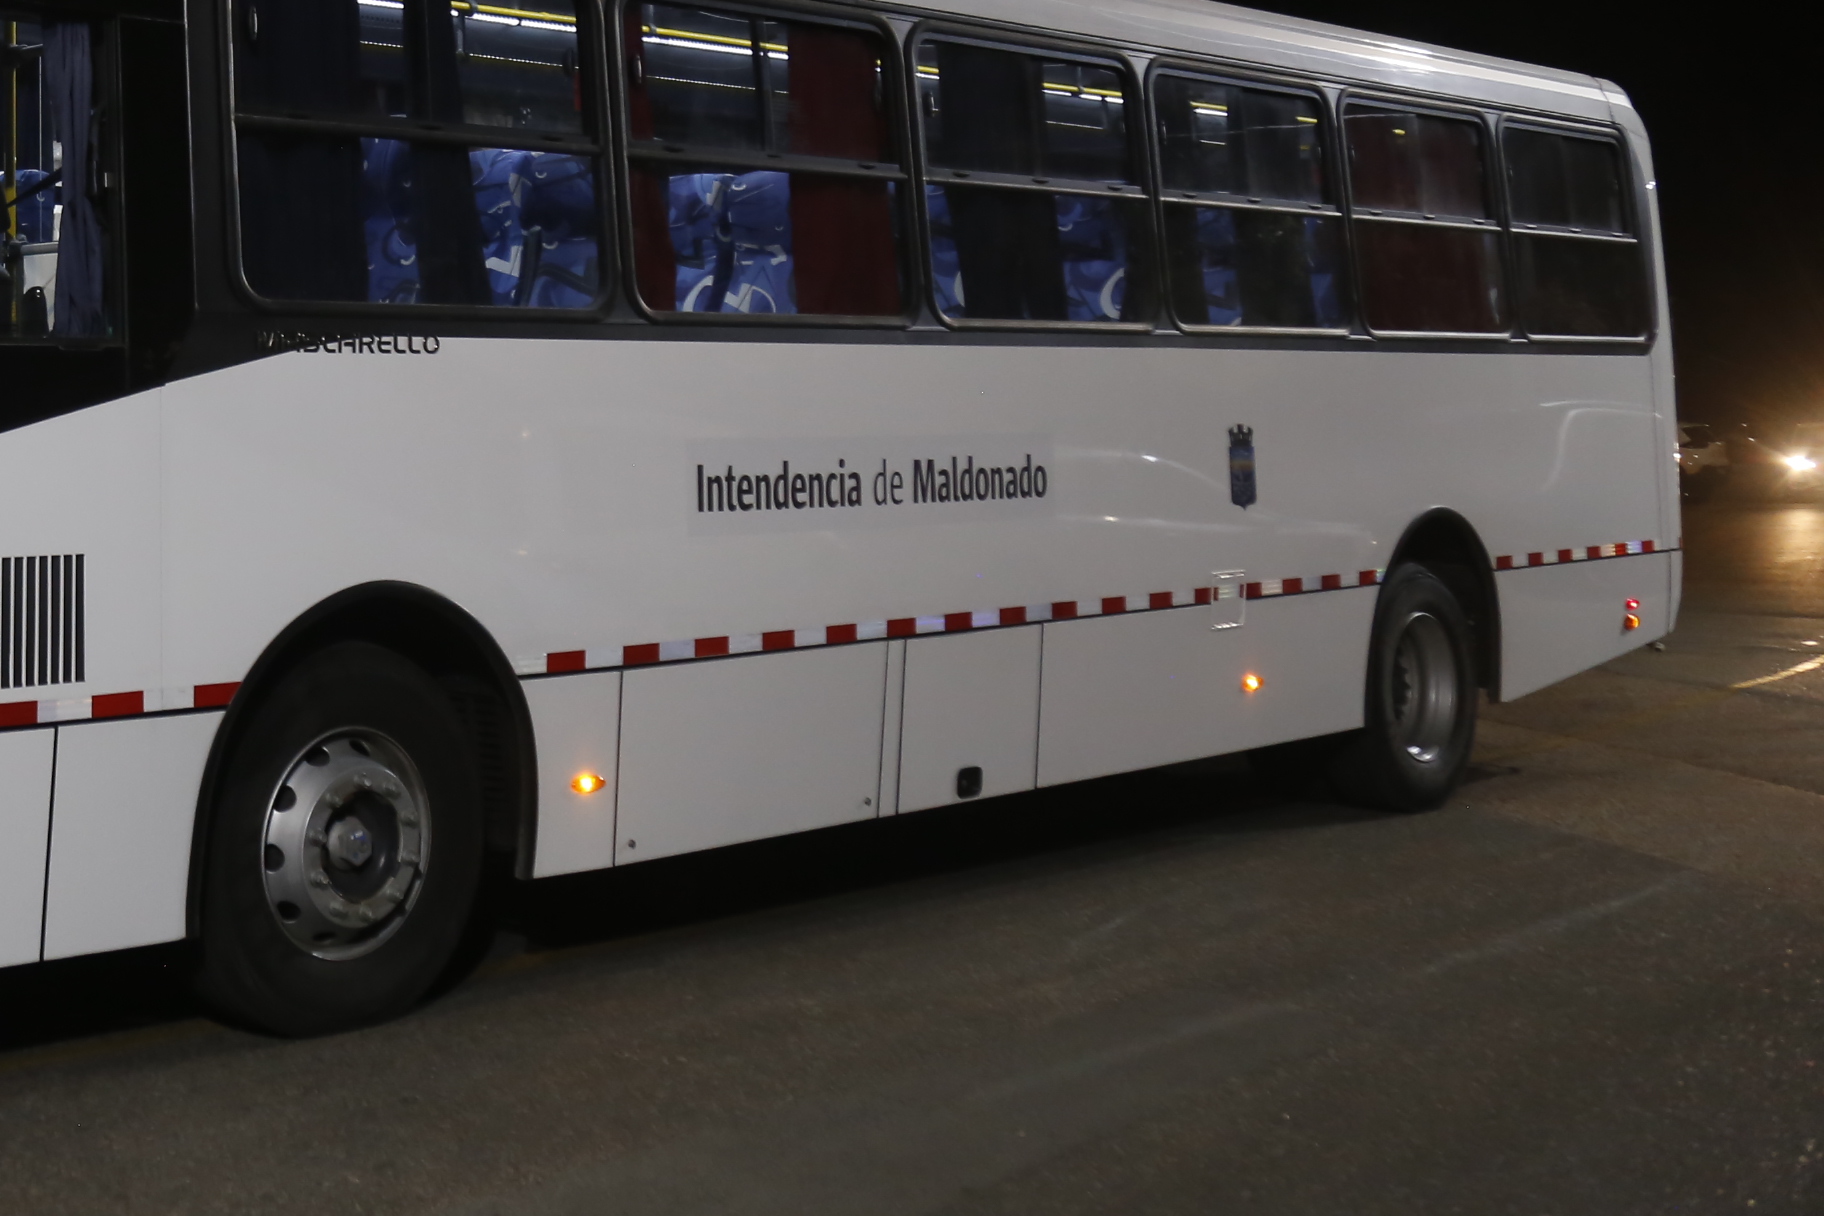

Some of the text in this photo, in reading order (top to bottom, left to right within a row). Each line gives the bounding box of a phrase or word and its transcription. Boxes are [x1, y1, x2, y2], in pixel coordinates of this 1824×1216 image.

[696, 453, 1048, 513] Intendencia de Maldonado
